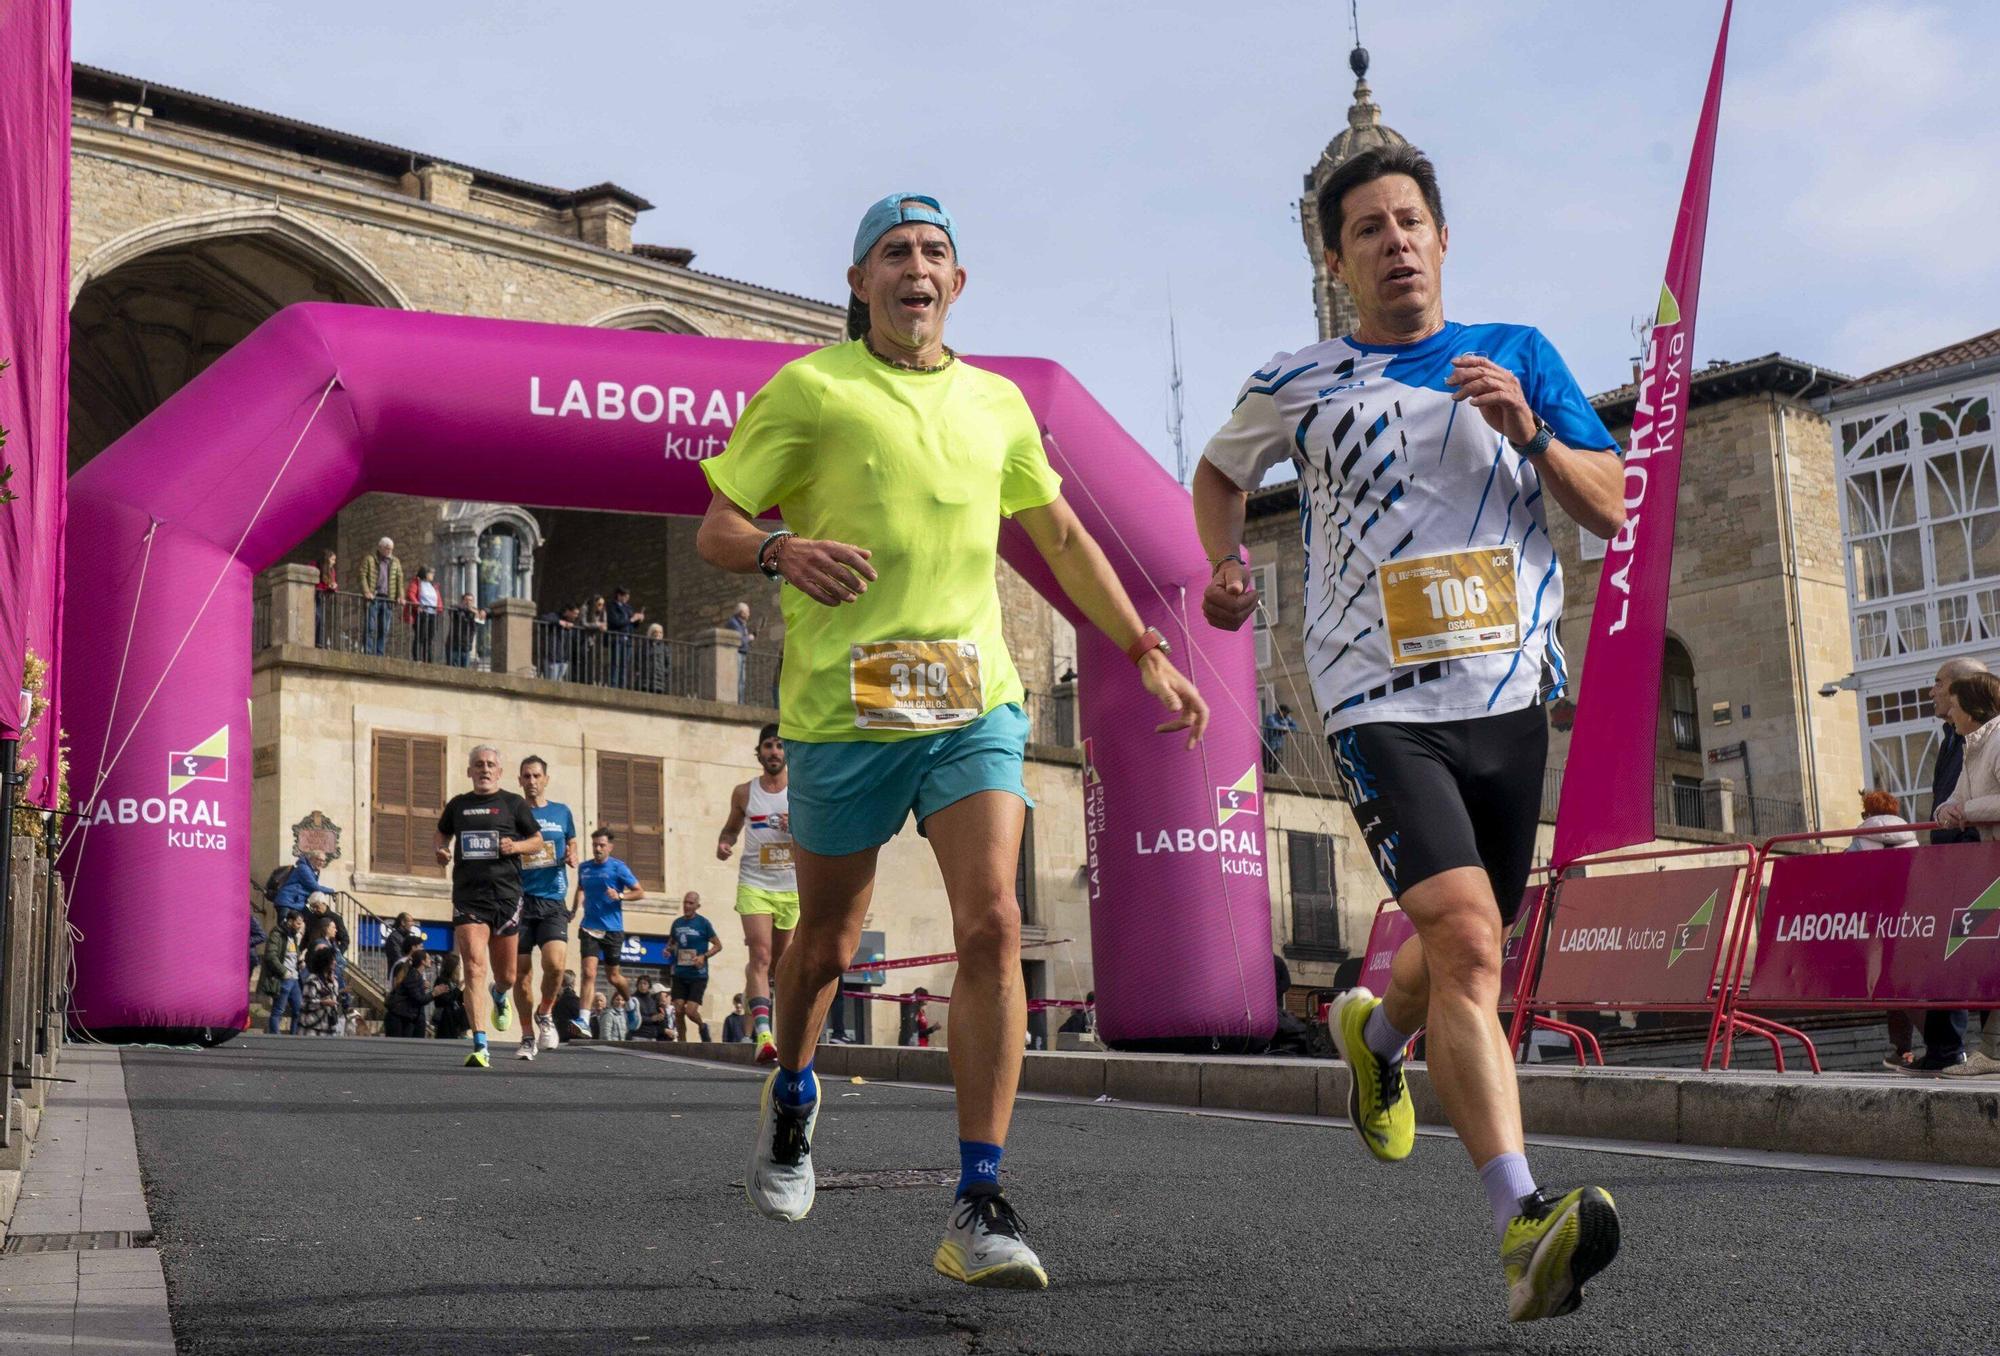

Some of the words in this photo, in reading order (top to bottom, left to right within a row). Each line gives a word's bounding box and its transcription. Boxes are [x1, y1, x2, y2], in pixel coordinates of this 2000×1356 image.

[1652, 332, 1685, 454] kutxa
[664, 432, 730, 461] kut
[1422, 575, 1488, 619] 106
[1448, 619, 1476, 631] OSCAR
[889, 662, 948, 697] 319
[916, 699, 947, 709] CARLOS
[78, 798, 227, 827] LABORAL
[1096, 785, 1106, 832] kutxa
[168, 829, 226, 850] kutxa
[469, 838, 491, 849] 1078
[1087, 788, 1100, 899] LABORAL
[1136, 828, 1261, 856] LABORAL
[769, 848, 790, 861] 539
[1221, 856, 1262, 877] kutxa
[1559, 927, 1622, 952] LABORAL
[1625, 928, 1666, 950] kutxa
[1776, 911, 1870, 942] LABORAL
[1875, 912, 1936, 938] kutxa
